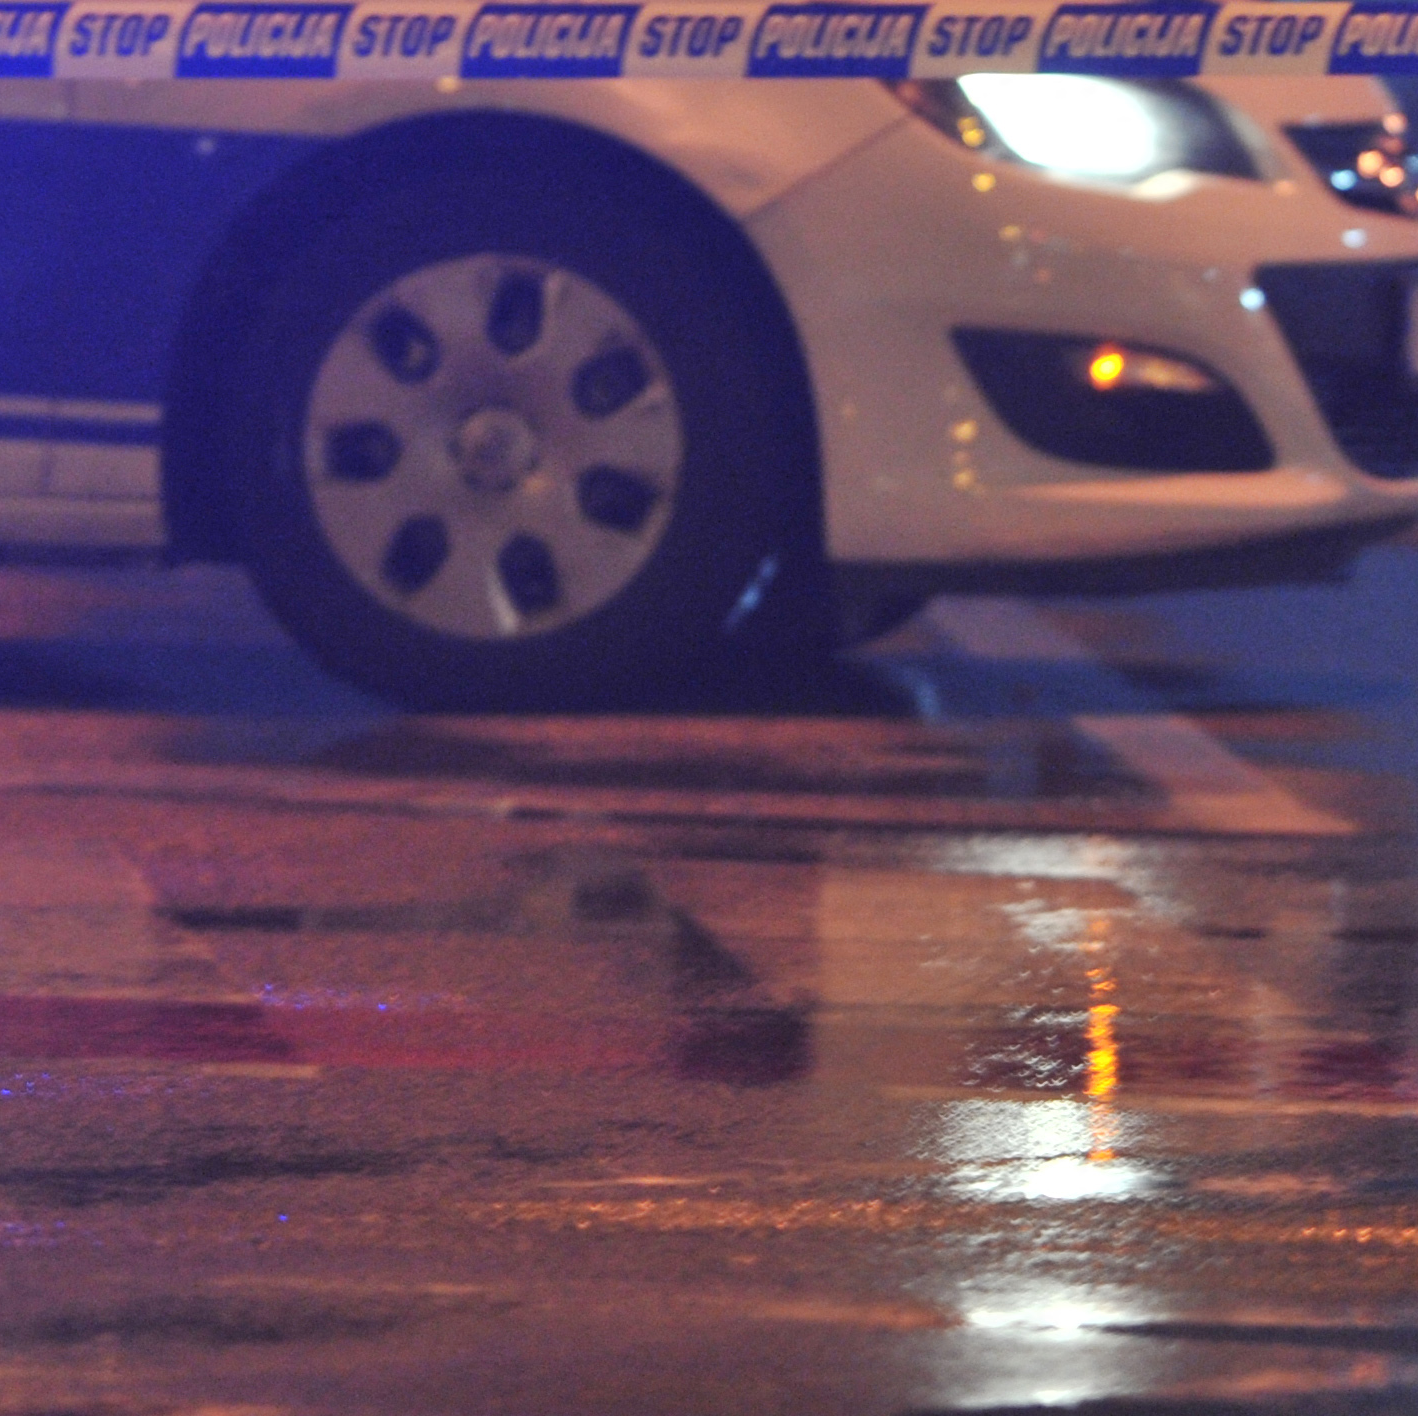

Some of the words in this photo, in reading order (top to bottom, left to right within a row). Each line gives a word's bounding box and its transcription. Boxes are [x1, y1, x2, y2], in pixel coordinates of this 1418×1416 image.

[69, 13, 171, 57] STOP
[188, 11, 344, 58] POLICIJA
[353, 14, 456, 57] STOP
[469, 13, 629, 59] POLICIJA
[639, 14, 744, 57] STOP
[755, 13, 915, 59] POLICIJA
[926, 14, 1034, 57] STOP
[1045, 13, 1206, 58] POLICIJA
[1219, 13, 1325, 56] STOP
